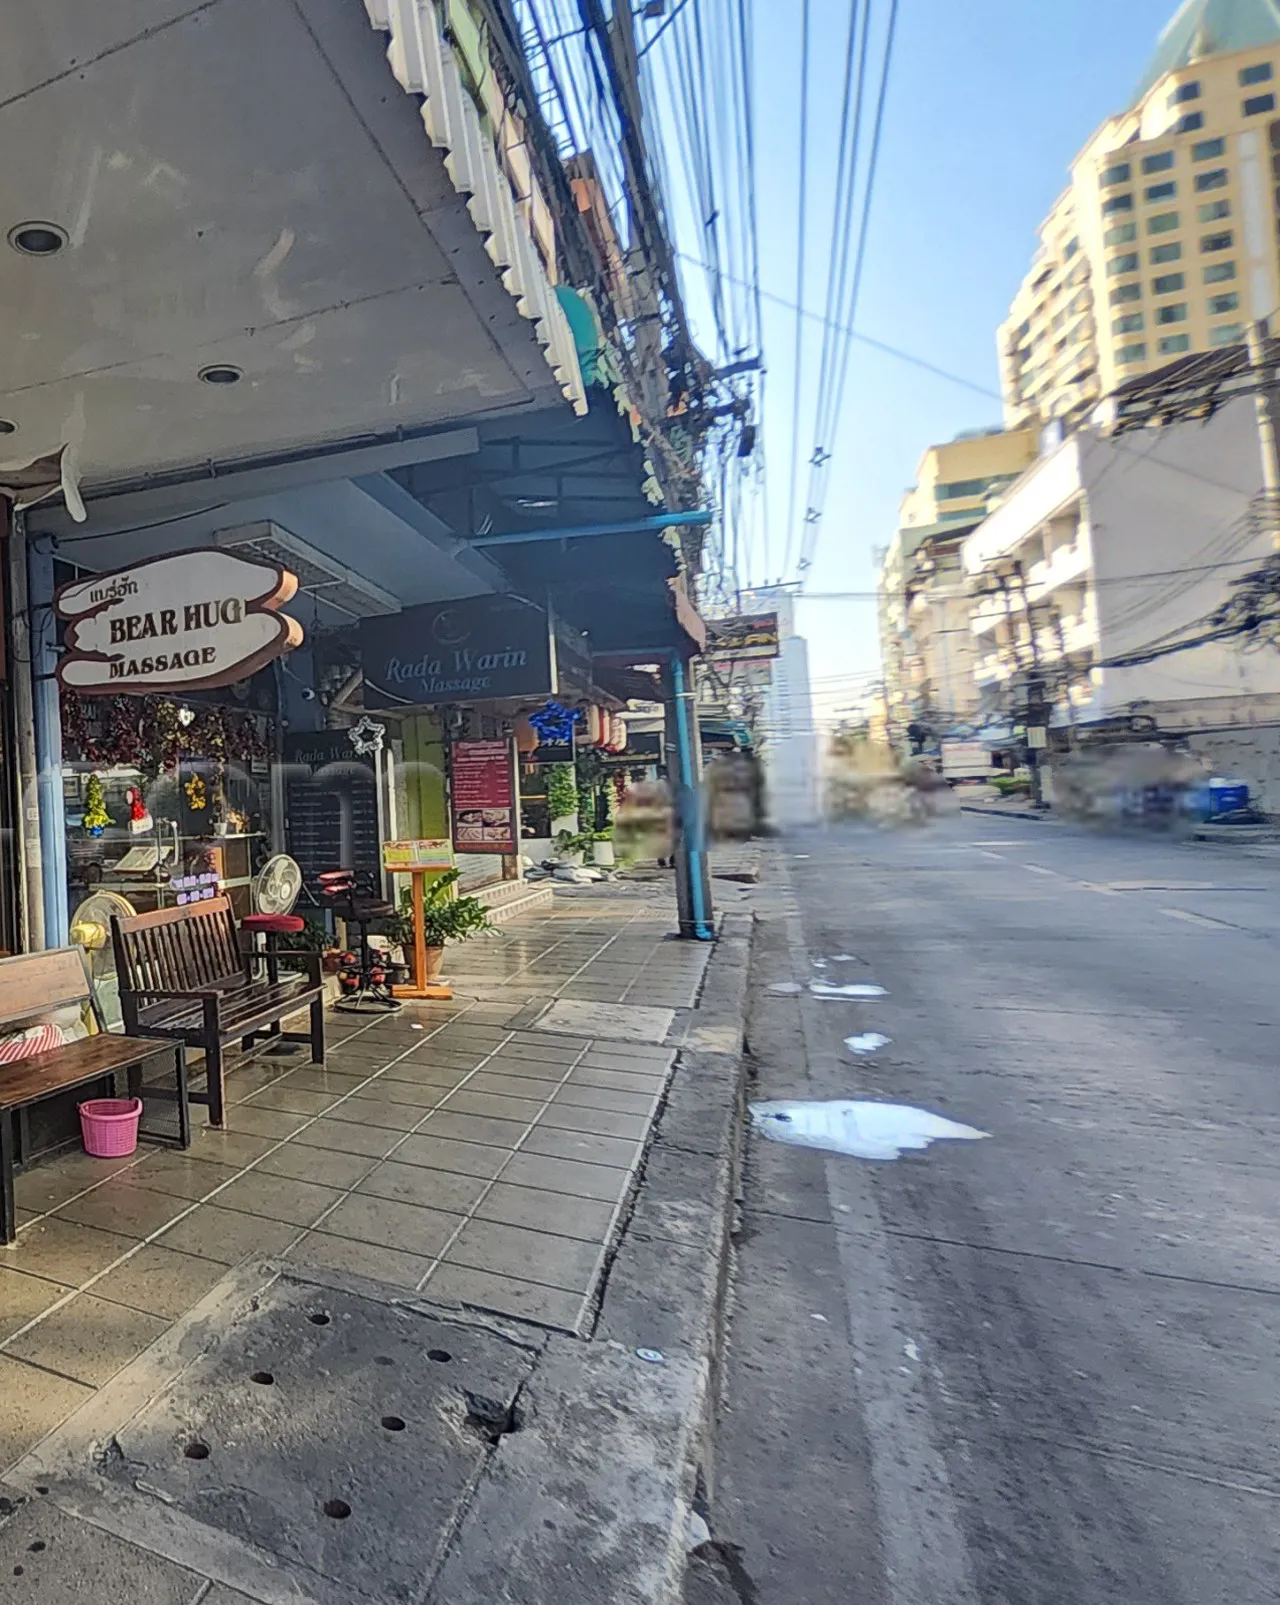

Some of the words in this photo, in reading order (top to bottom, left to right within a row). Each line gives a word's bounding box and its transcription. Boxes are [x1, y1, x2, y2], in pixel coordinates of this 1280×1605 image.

[90, 575, 139, 603] แบร์ฮัก
[109, 608, 179, 645] BEAR
[183, 597, 243, 632] HUG
[385, 653, 442, 684] Rada
[453, 645, 528, 673] Warin
[420, 675, 492, 694] Massage
